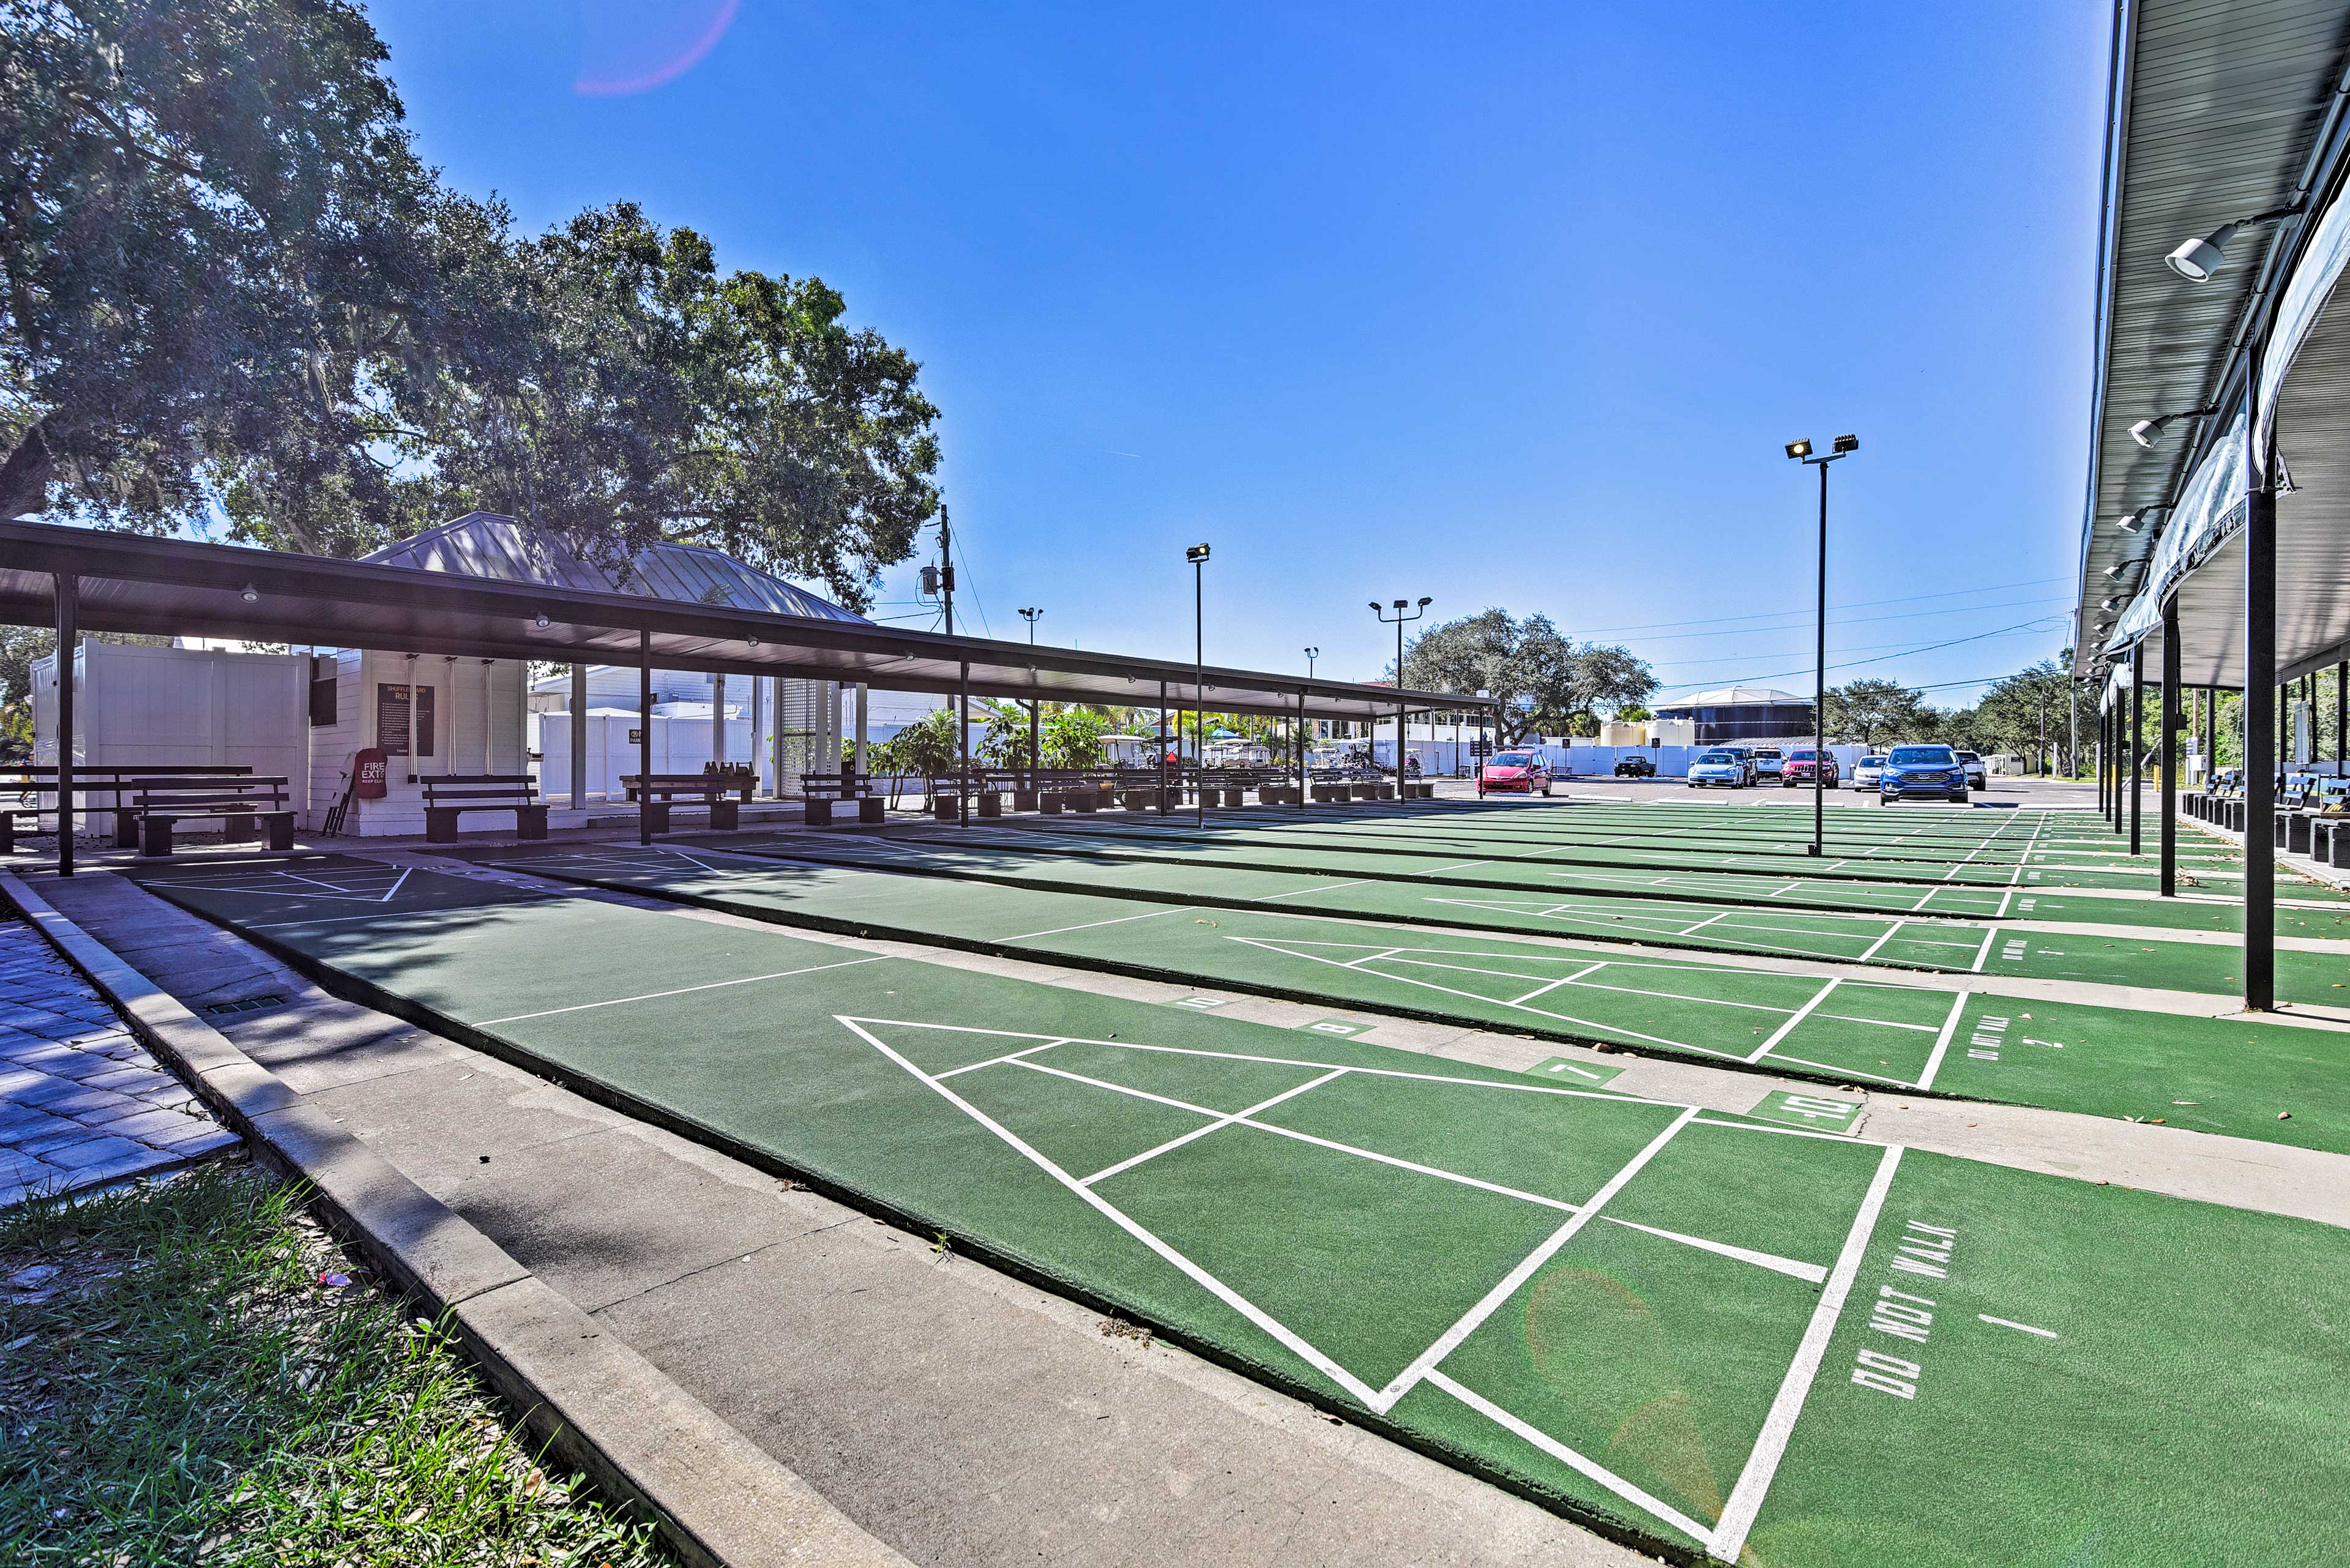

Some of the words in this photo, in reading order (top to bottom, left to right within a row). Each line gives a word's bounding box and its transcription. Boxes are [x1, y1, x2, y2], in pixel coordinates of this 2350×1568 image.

[1175, 997, 1226, 1009] 10
[1310, 1023, 1357, 1034] 8
[1548, 1064, 1601, 1080] 7
[1890, 1219, 1958, 1279] WALK
[1869, 1285, 1937, 1344] NOT
[1851, 1348, 1922, 1400] DO
